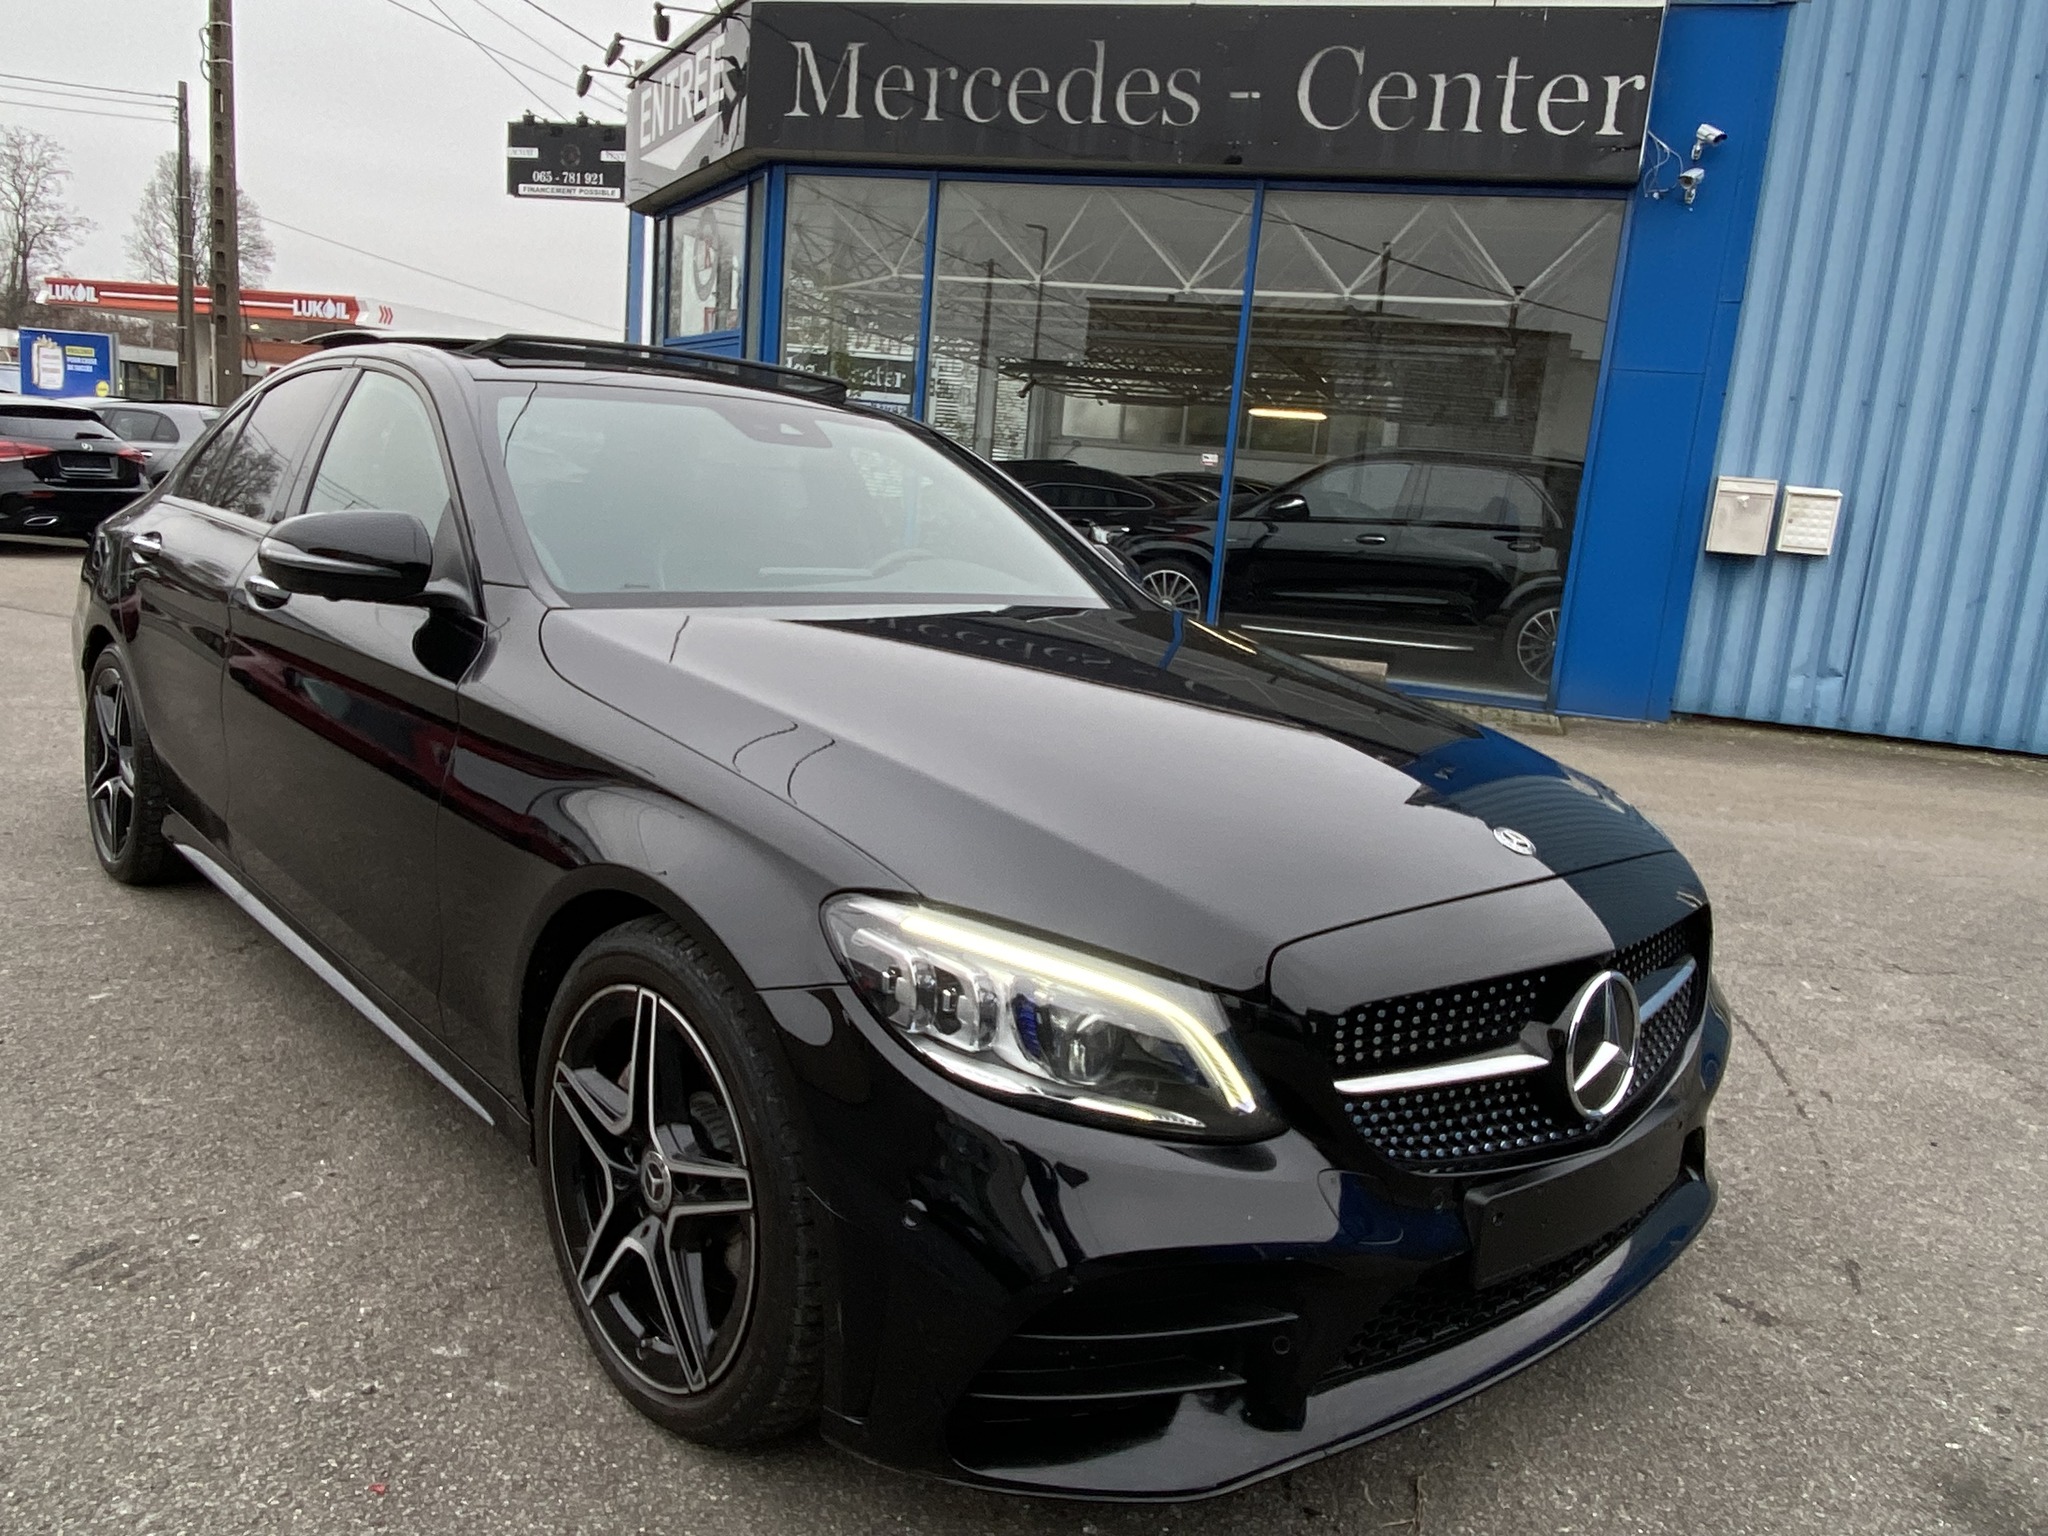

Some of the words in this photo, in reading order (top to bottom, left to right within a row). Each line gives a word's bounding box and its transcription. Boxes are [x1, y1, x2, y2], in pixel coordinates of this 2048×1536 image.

[640, 33, 725, 149] ENTREE
[783, 39, 1201, 127] Mercedes
[1229, 91, 1261, 99] -
[1297, 45, 1646, 136] Center
[532, 170, 553, 183] 065
[562, 171, 581, 185] 781
[584, 172, 604, 186] 921
[522, 186, 577, 195] FINANCEMENT
[578, 188, 617, 197] POSSIBLE
[48, 283, 99, 302] LUKOIL
[293, 298, 350, 319] LUKOIL
